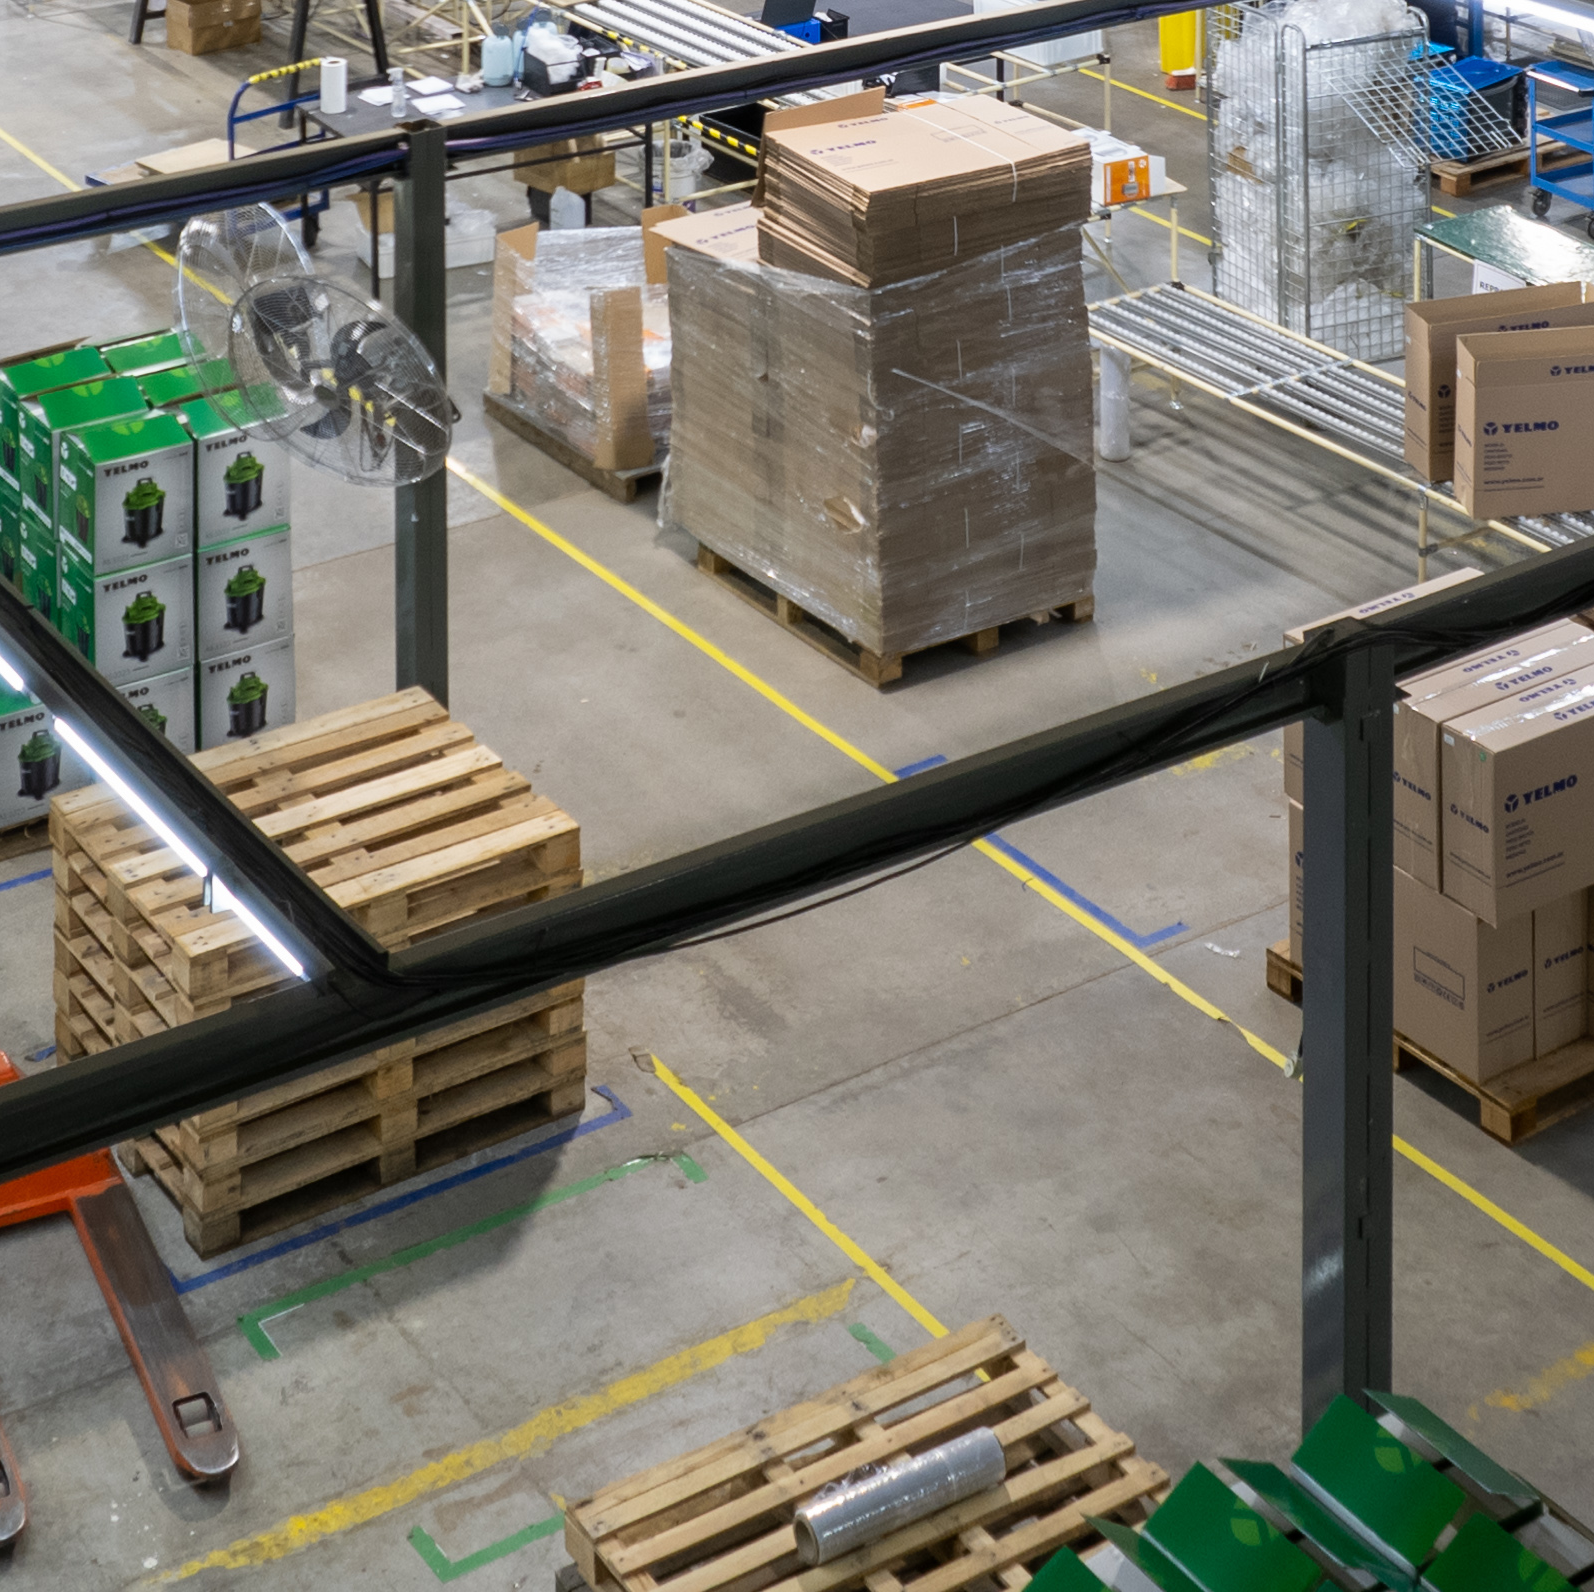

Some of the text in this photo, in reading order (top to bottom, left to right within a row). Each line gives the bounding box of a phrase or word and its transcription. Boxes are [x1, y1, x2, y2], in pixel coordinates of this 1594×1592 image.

[826, 139, 877, 152] YELMO
[1502, 420, 1560, 434] YELMO
[103, 459, 149, 477] YELMO
[206, 548, 250, 566] YELMO
[103, 574, 149, 592] YELMO
[208, 655, 252, 674] YELMO
[1509, 666, 1553, 686] YELMO
[0, 712, 46, 732] YELMO
[1523, 774, 1578, 805] YELMO
[1459, 810, 1490, 835] YELMO
